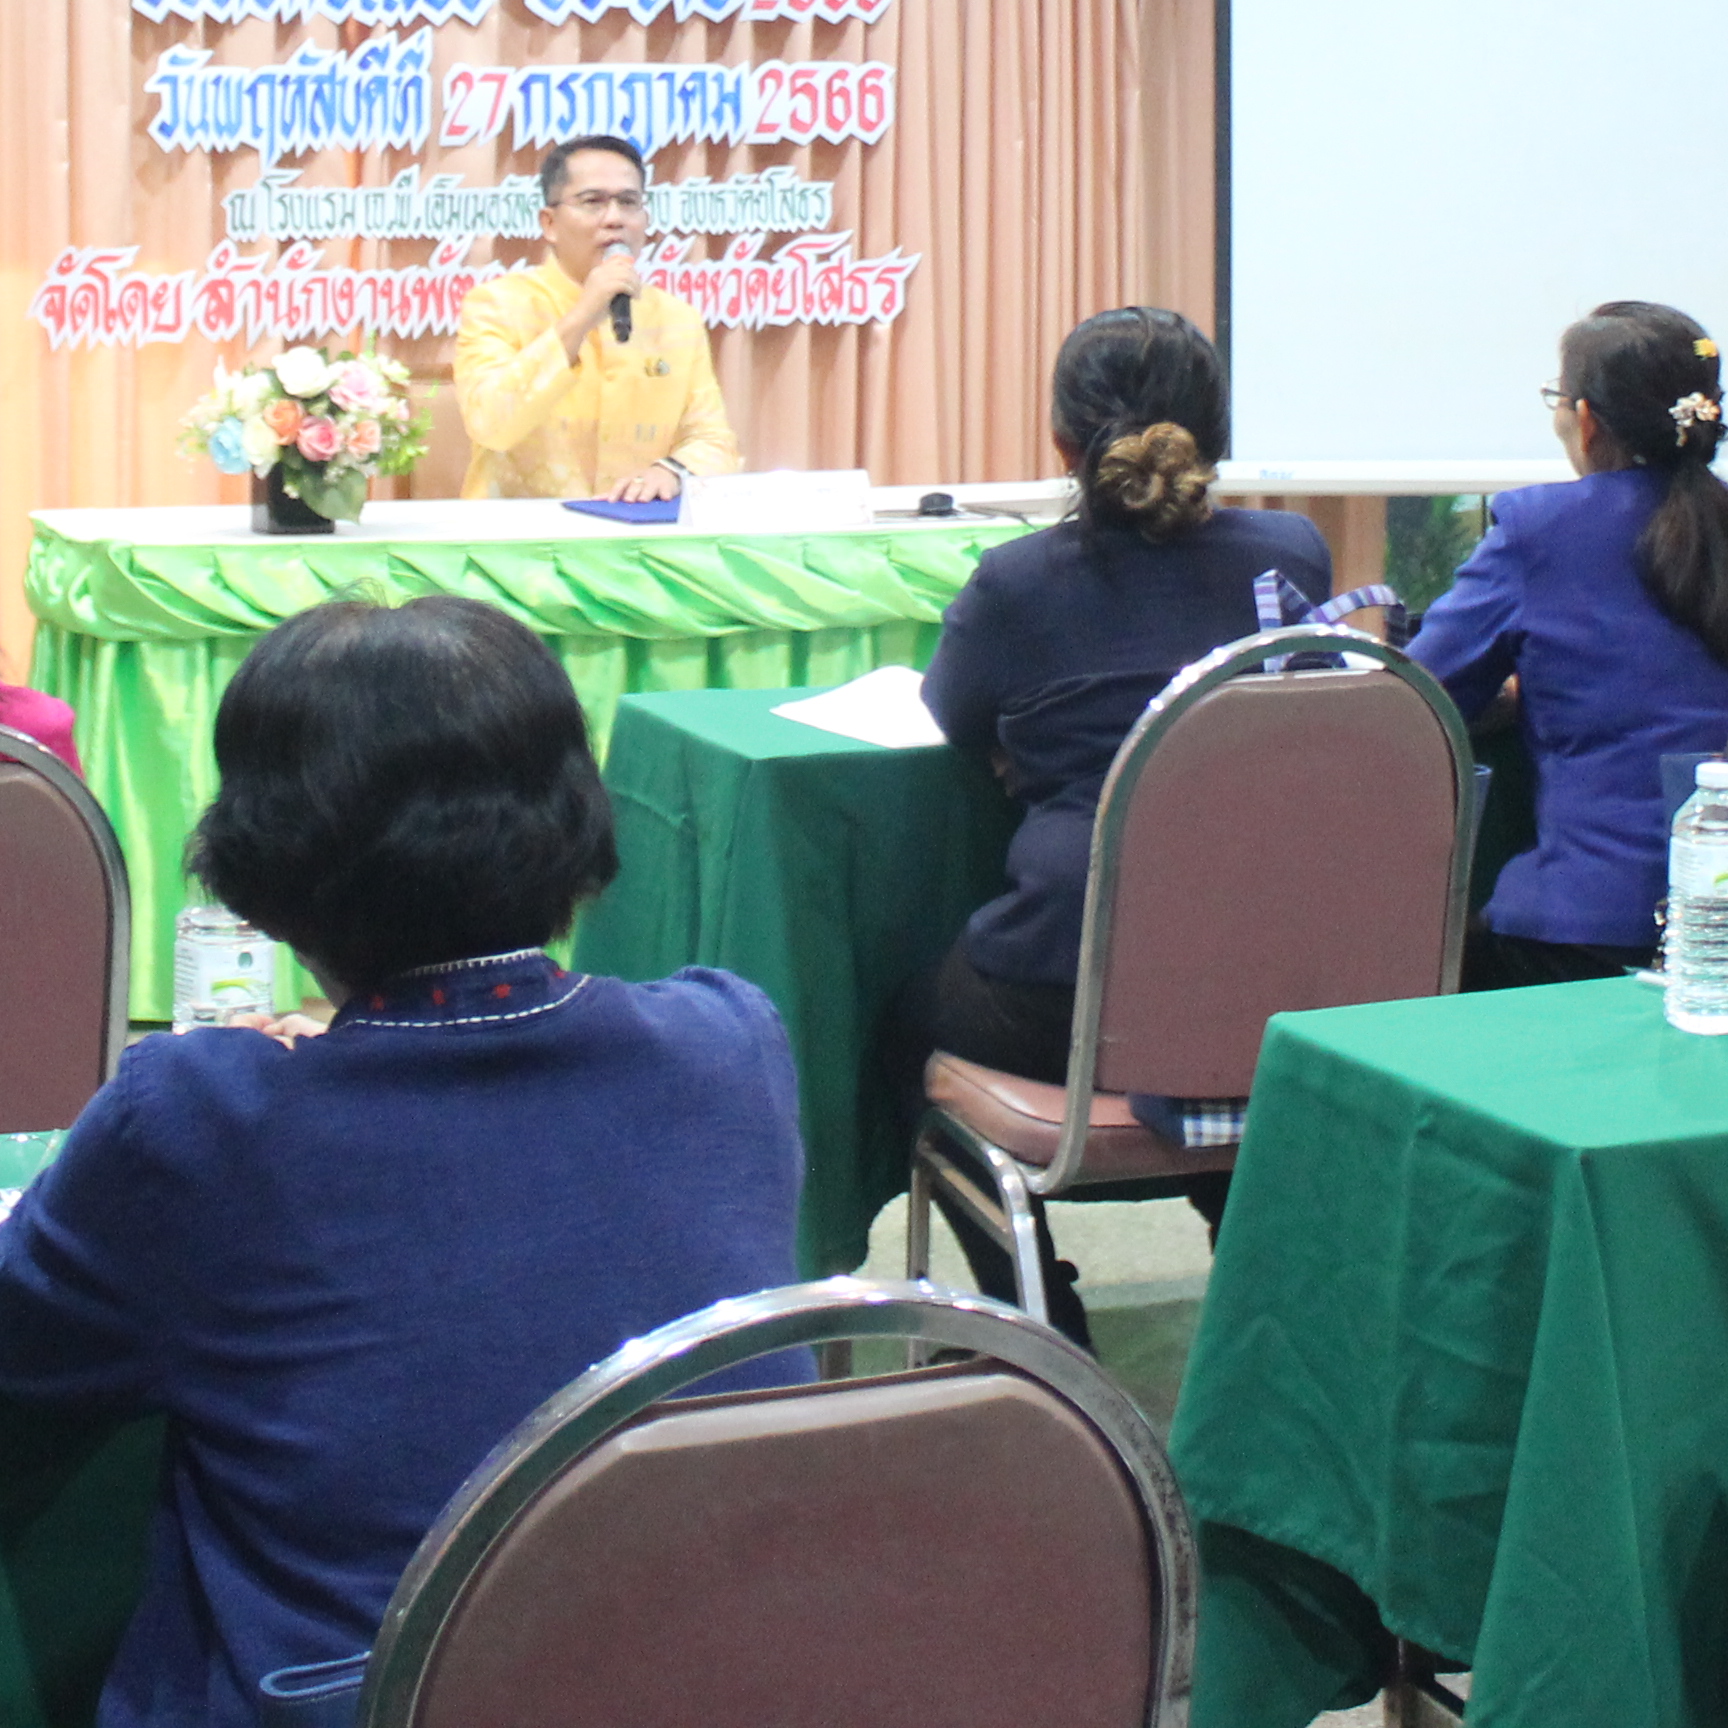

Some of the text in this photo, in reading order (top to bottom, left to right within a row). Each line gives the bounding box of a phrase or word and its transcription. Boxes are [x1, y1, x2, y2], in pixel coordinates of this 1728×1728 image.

[157, 34, 886, 164] วันพฤหัสบดีที่ 27 กรกฎาคม 2566
[36, 251, 183, 334] จัดโดย
